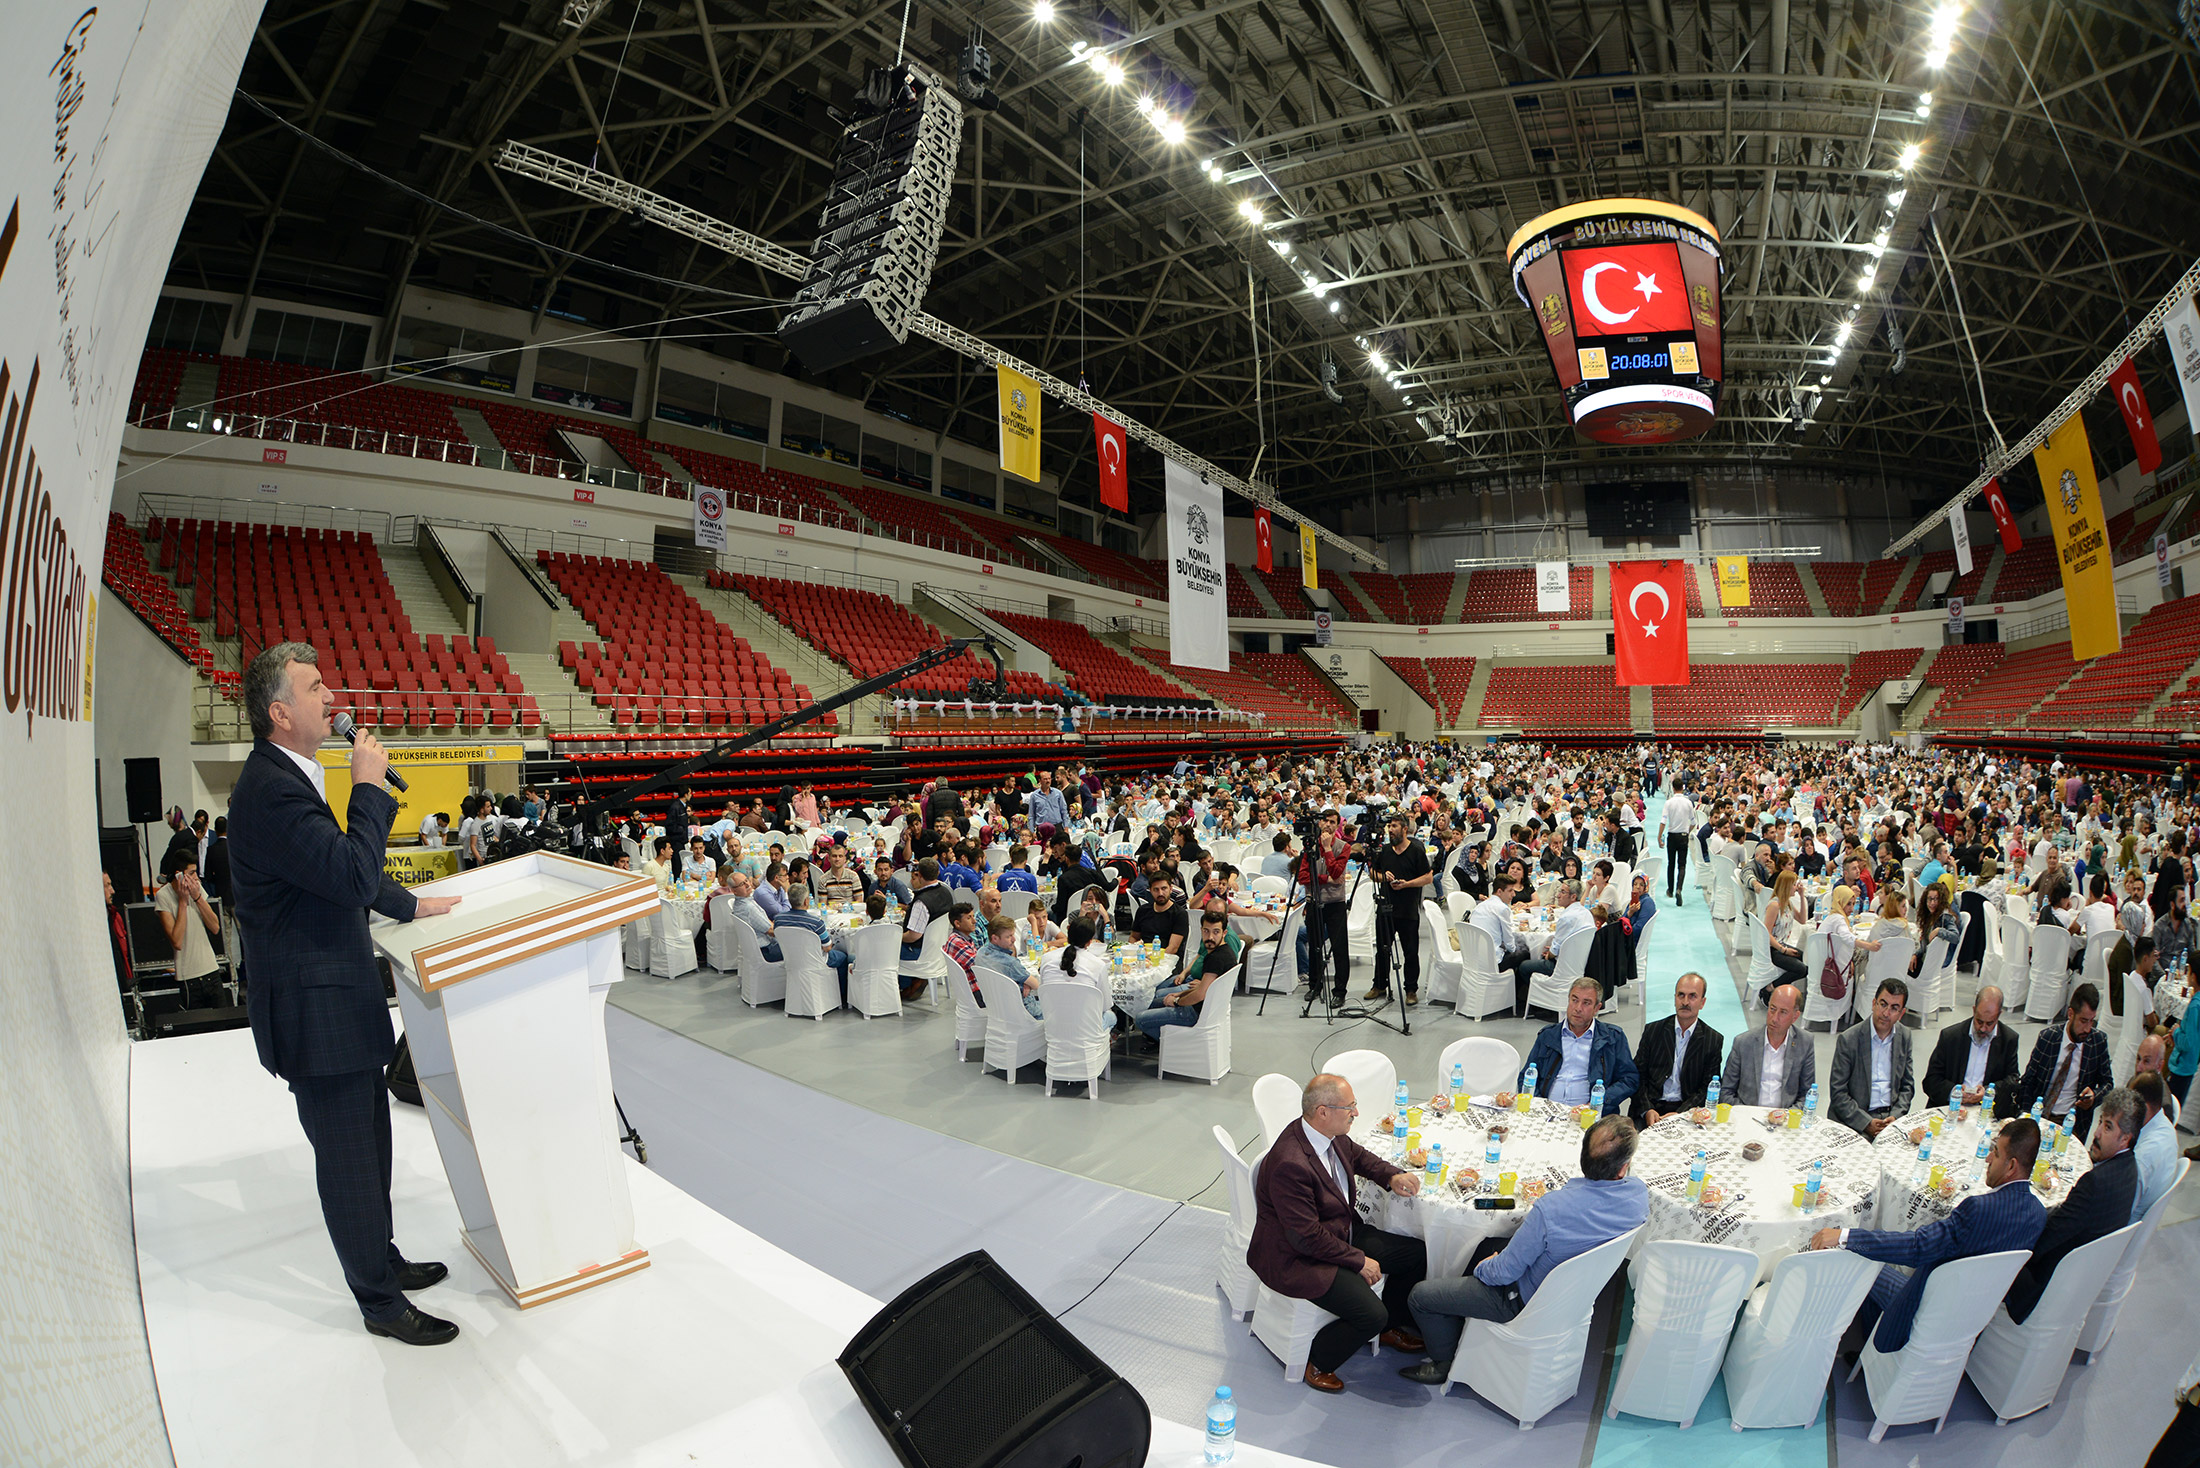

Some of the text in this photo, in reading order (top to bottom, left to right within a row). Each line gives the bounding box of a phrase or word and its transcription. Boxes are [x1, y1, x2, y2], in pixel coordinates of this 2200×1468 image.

[1574, 218, 1679, 241] BÜYÜKŞEHİR
[1611, 352, 1668, 370] 20:08:01
[1662, 388, 1684, 398] SPOR
[1010, 410, 1027, 423] KONYA
[265, 451, 284, 461] VIP 5
[576, 491, 586, 499] VIP
[699, 519, 723, 531] KONYA
[2067, 517, 2089, 539] KONYA
[1188, 547, 1211, 565] KONYA
[1187, 580, 1214, 596] BELEDİYESİ
[388, 750, 483, 761] BÜYÜKŞEHİR BELEDİYESİ
